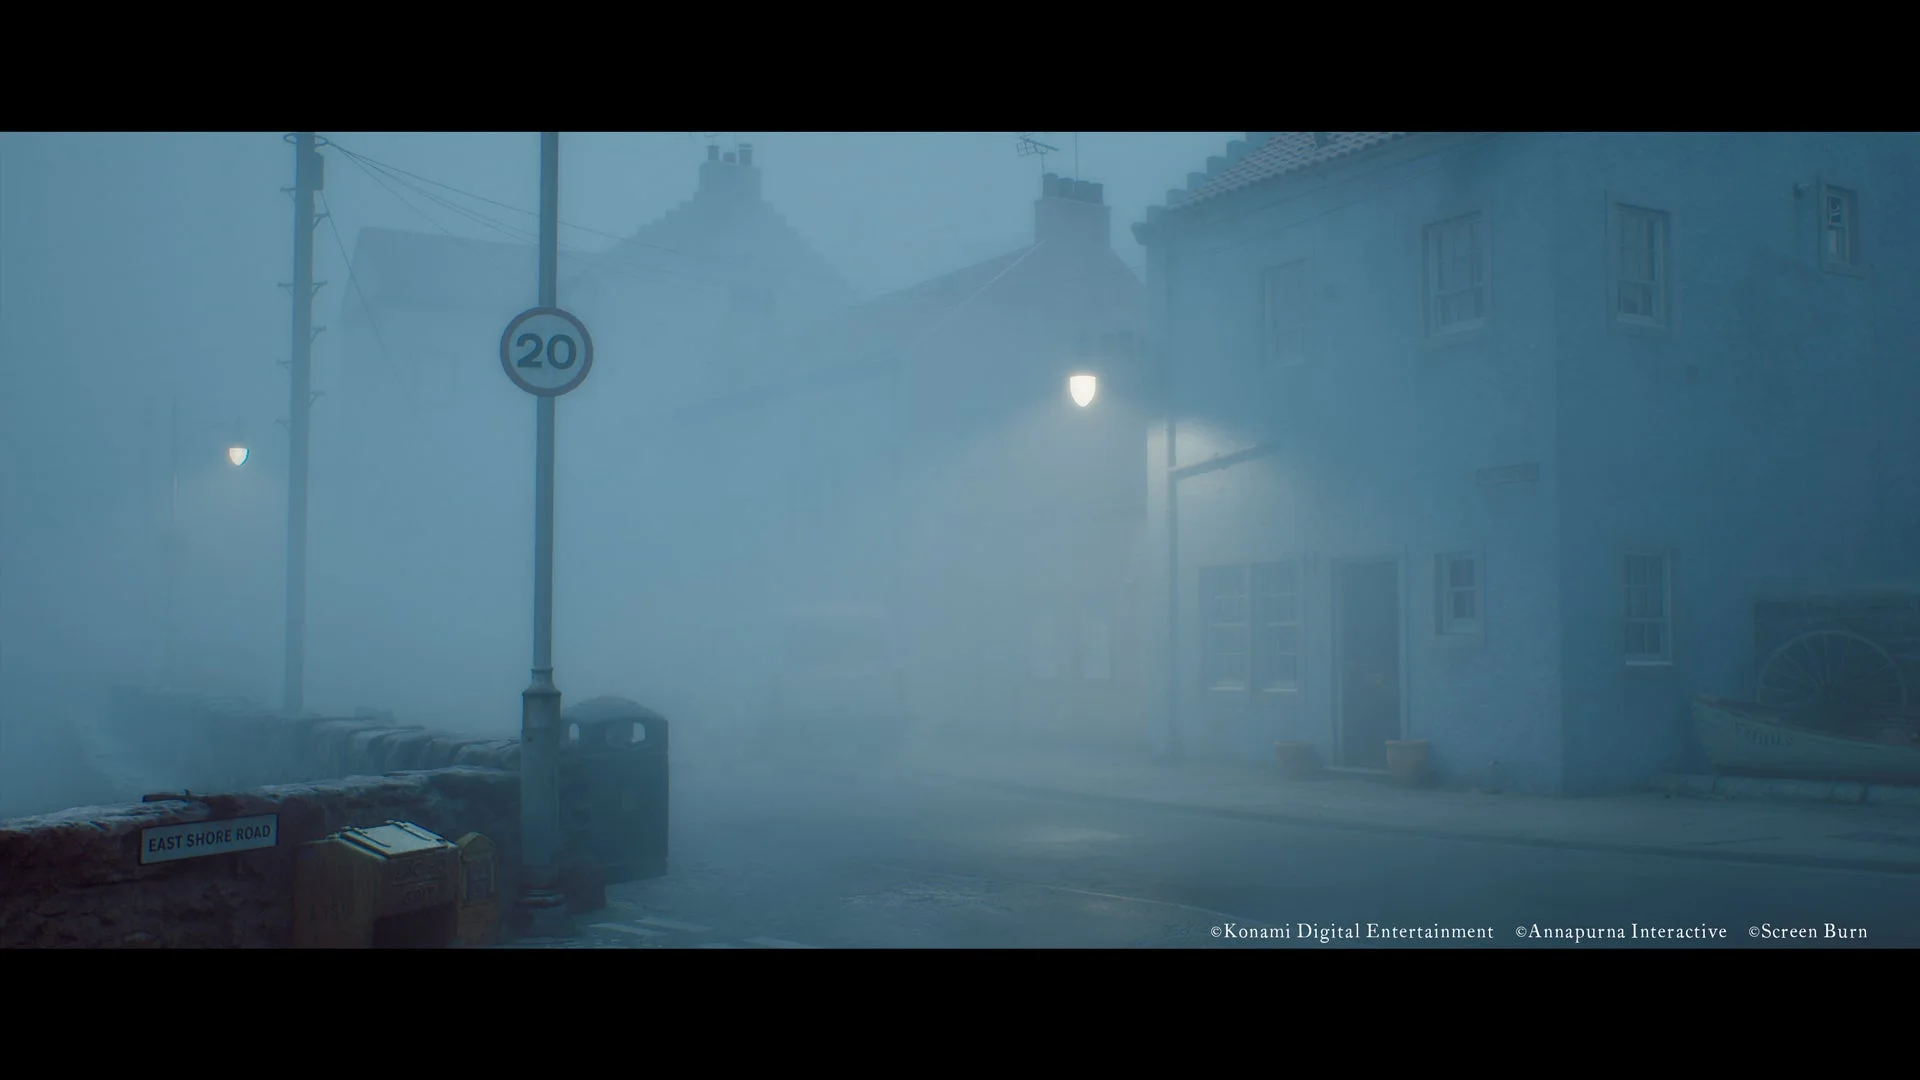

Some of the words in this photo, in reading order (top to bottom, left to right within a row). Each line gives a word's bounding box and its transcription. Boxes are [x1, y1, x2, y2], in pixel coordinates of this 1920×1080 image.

[516, 333, 577, 370] 20
[148, 834, 184, 853] EAST
[186, 829, 233, 848] SHORE
[236, 825, 272, 841] ROAD
